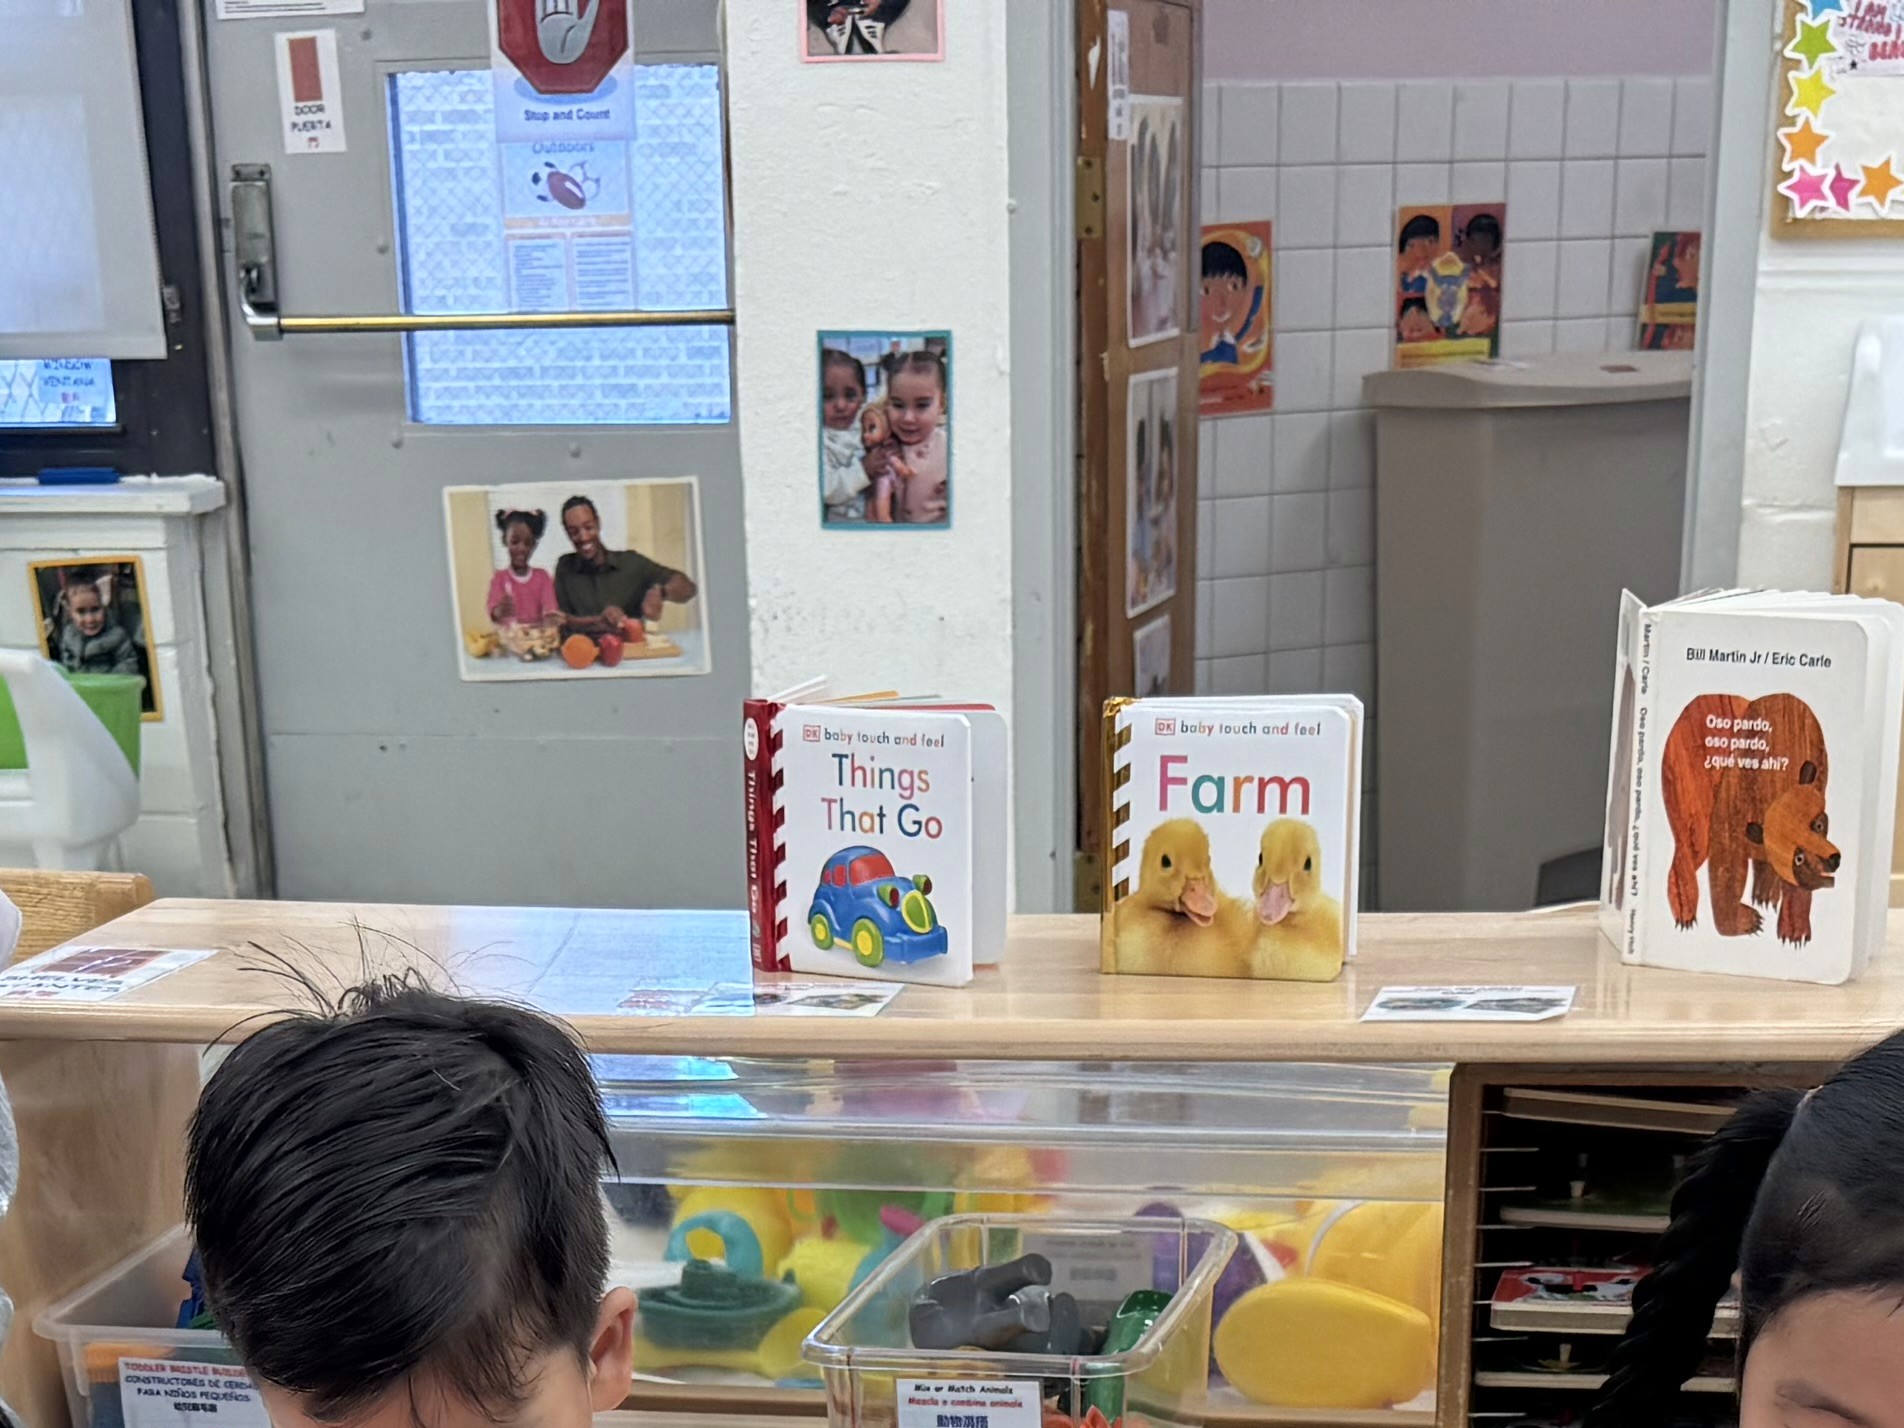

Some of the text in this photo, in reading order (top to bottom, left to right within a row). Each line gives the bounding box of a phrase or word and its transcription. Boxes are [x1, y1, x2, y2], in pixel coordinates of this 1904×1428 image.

[1686, 648, 1706, 661] Bill
[1709, 649, 1747, 664] Martin
[1749, 650, 1762, 664] Jr
[1772, 652, 1796, 666] Eric
[1799, 654, 1832, 668] Carle
[1181, 720, 1214, 736] baby
[1220, 720, 1257, 735] touch
[1262, 722, 1289, 735] and
[1295, 721, 1321, 736] feel
[1706, 714, 1773, 733] Oso pardo,
[824, 728, 853, 745] baby
[857, 731, 890, 744] touch
[894, 733, 917, 746] and
[921, 734, 944, 747] feel
[1704, 736, 1770, 753] oso pardo,
[1738, 757, 1759, 770] ves
[831, 752, 930, 800] Things
[1159, 754, 1311, 816] Farm
[821, 796, 943, 839] That Go
